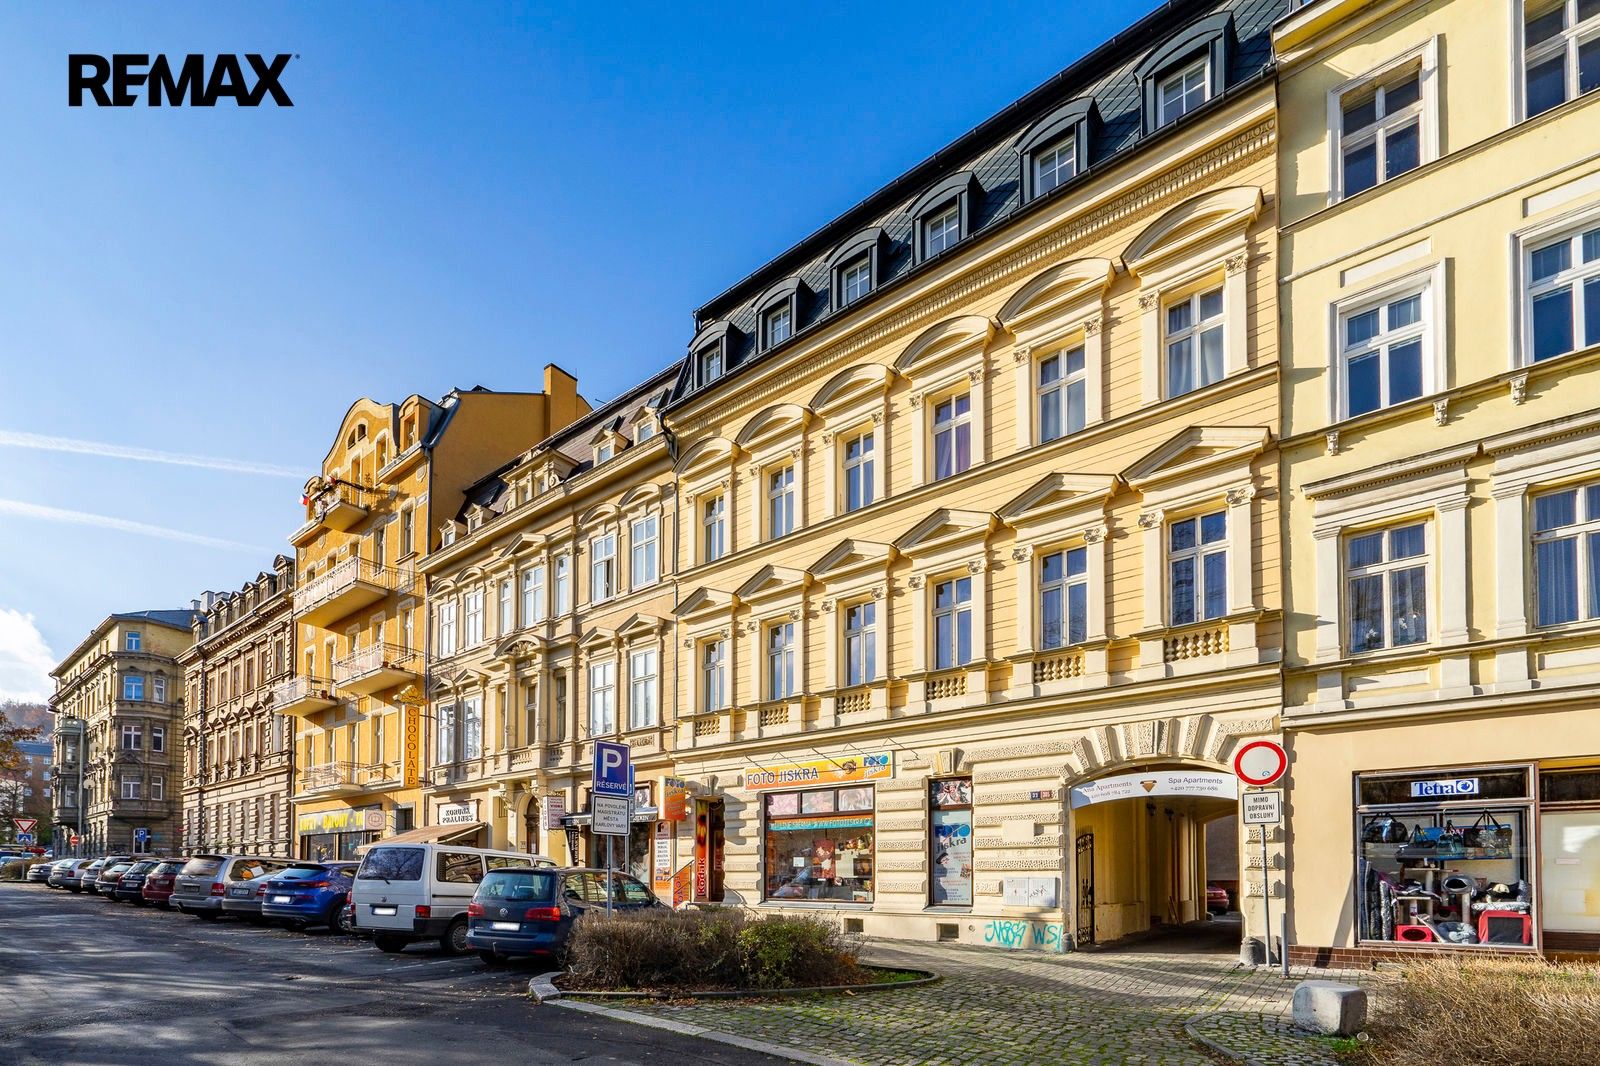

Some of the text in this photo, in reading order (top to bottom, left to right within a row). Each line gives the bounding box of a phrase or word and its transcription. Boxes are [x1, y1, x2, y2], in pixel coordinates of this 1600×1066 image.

[407, 708, 417, 785] CHOCOLATE
[602, 748, 622, 778] P
[863, 753, 889, 767] FOTO
[747, 767, 819, 785] FOTO JISKRA
[1168, 777, 1223, 785] Spa Apartments
[1096, 781, 1132, 791] Apartments
[1414, 782, 1455, 796] Tetra
[1248, 803, 1275, 811] DOPRAVNÍ
[935, 825, 971, 837] FOTO
[697, 859, 705, 894] Kodak
